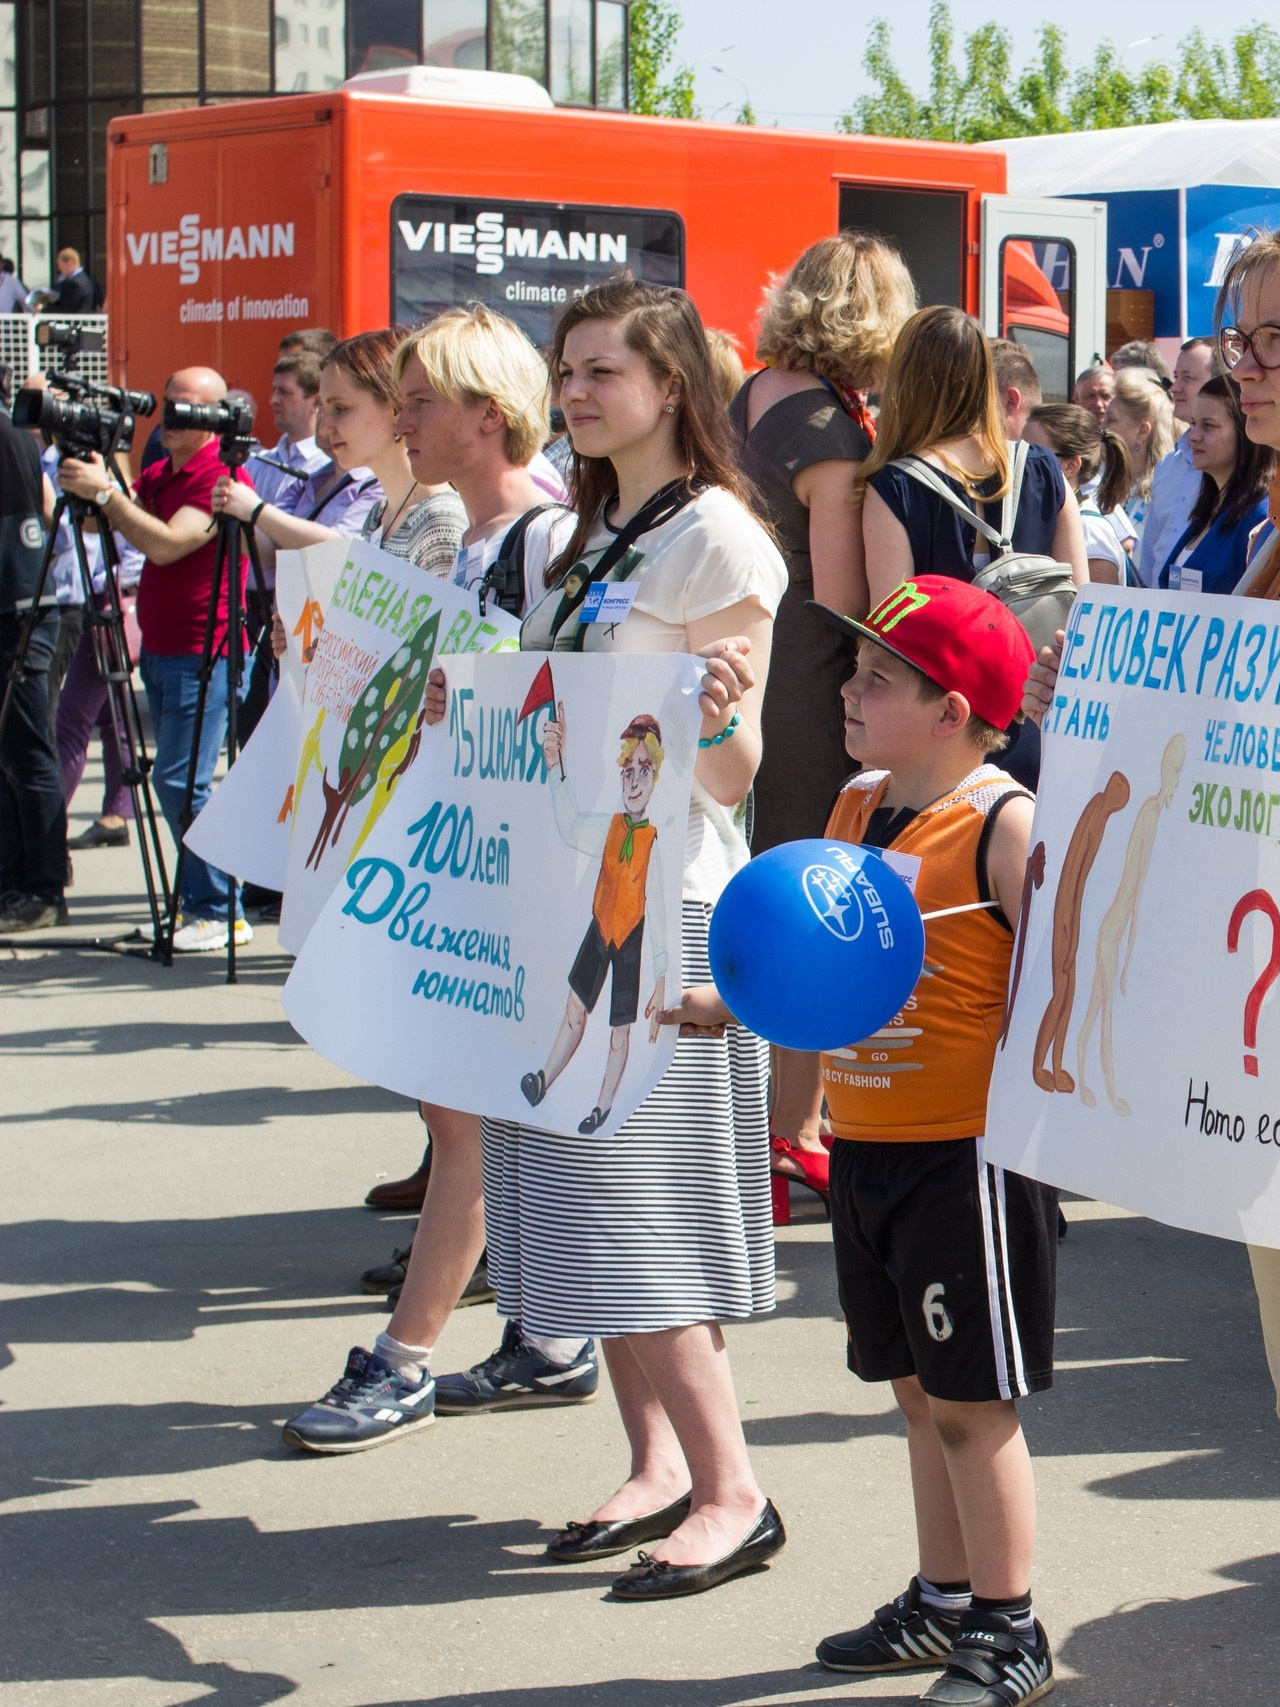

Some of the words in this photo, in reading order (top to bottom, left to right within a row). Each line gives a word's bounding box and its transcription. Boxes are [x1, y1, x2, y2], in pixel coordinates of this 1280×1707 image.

[126, 213, 295, 285] VIESSMANN
[398, 212, 627, 274] VIESSMANN
[180, 298, 224, 324] climate
[227, 295, 240, 321] of
[242, 293, 309, 320] innovation
[506, 281, 567, 302] climate
[330, 560, 433, 643] ЕЛЕНАЯ
[450, 688, 475, 777] 15
[406, 801, 473, 879] 100
[470, 822, 510, 887] лет
[341, 857, 511, 972] Движения
[825, 846, 895, 950] SUBARU
[412, 965, 525, 1022] юннатов
[844, 1073, 891, 1088] FASHION
[871, 1052, 889, 1062] GO
[1185, 1077, 1245, 1143] Homo
[922, 1282, 954, 1342] 6
